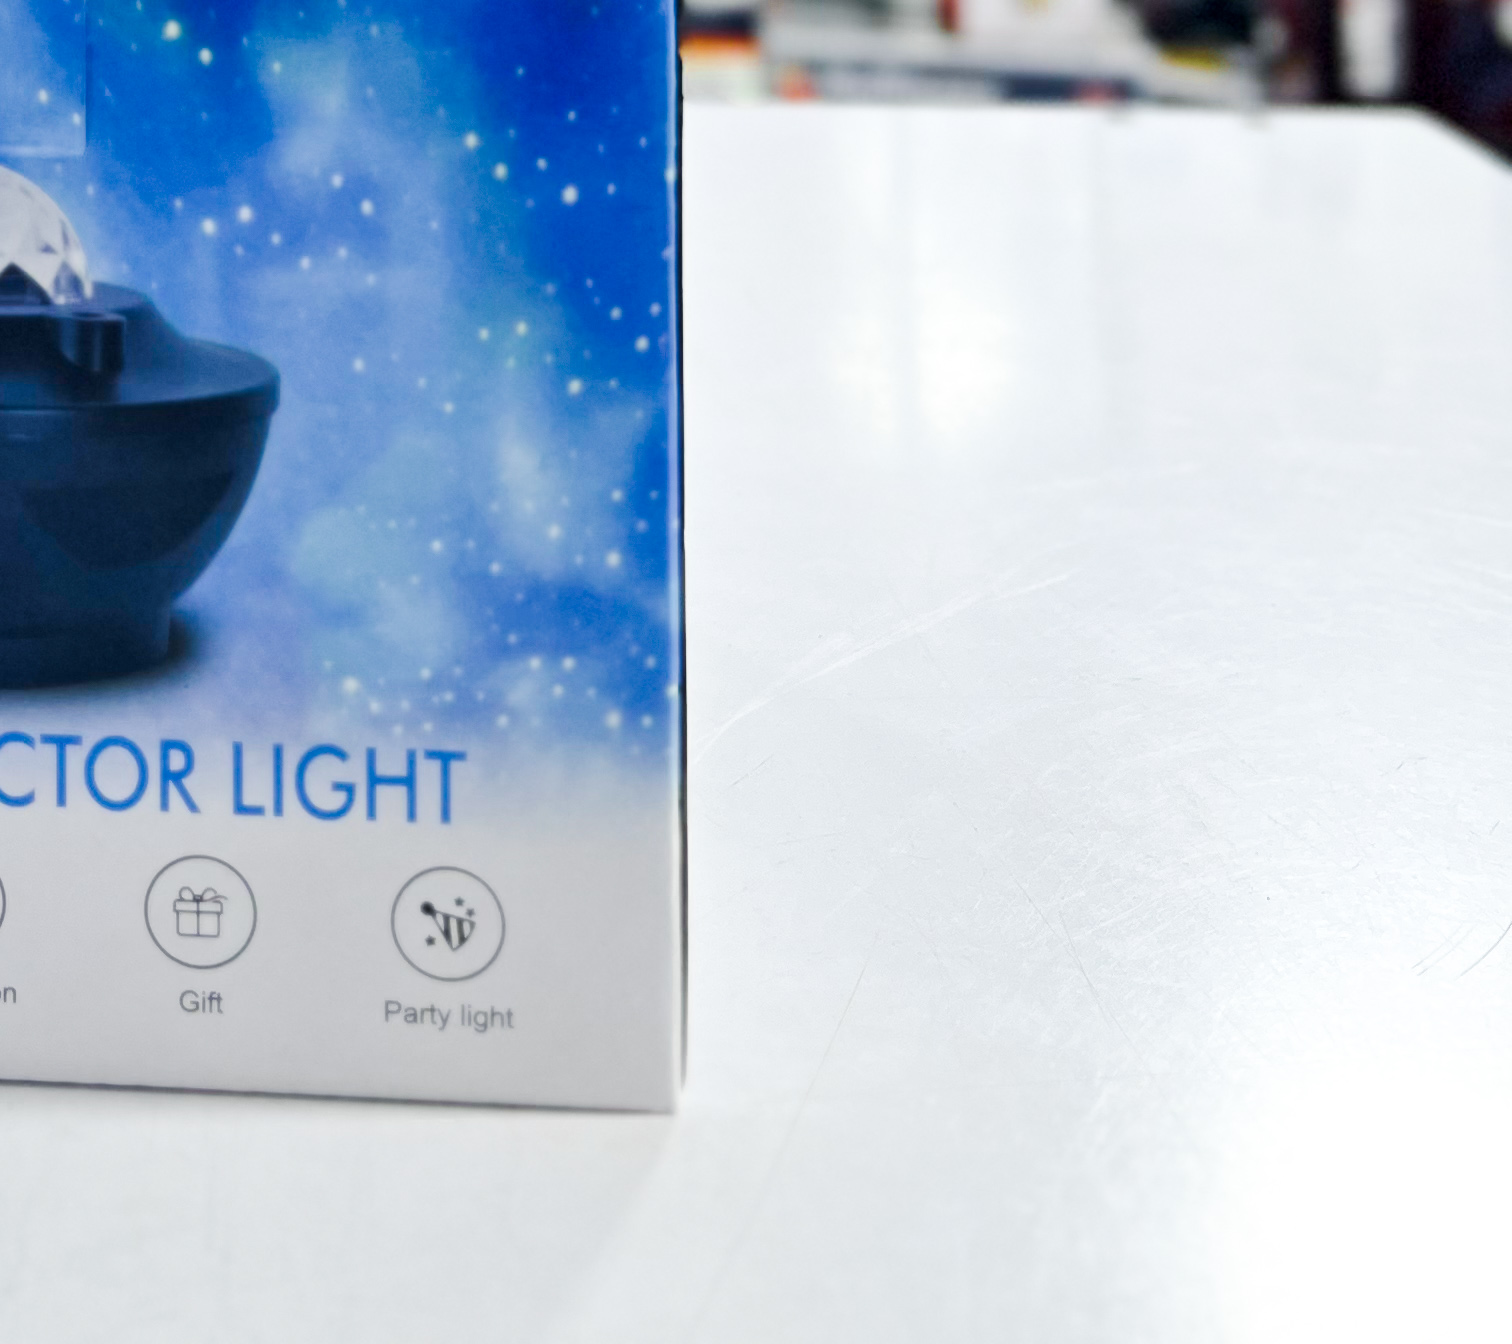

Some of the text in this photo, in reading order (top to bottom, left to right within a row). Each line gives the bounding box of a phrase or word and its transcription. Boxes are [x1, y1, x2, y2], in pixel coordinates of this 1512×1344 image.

[232, 741, 468, 825] LIGHT
[179, 989, 224, 1014] Gift
[384, 999, 515, 1034] Party light
